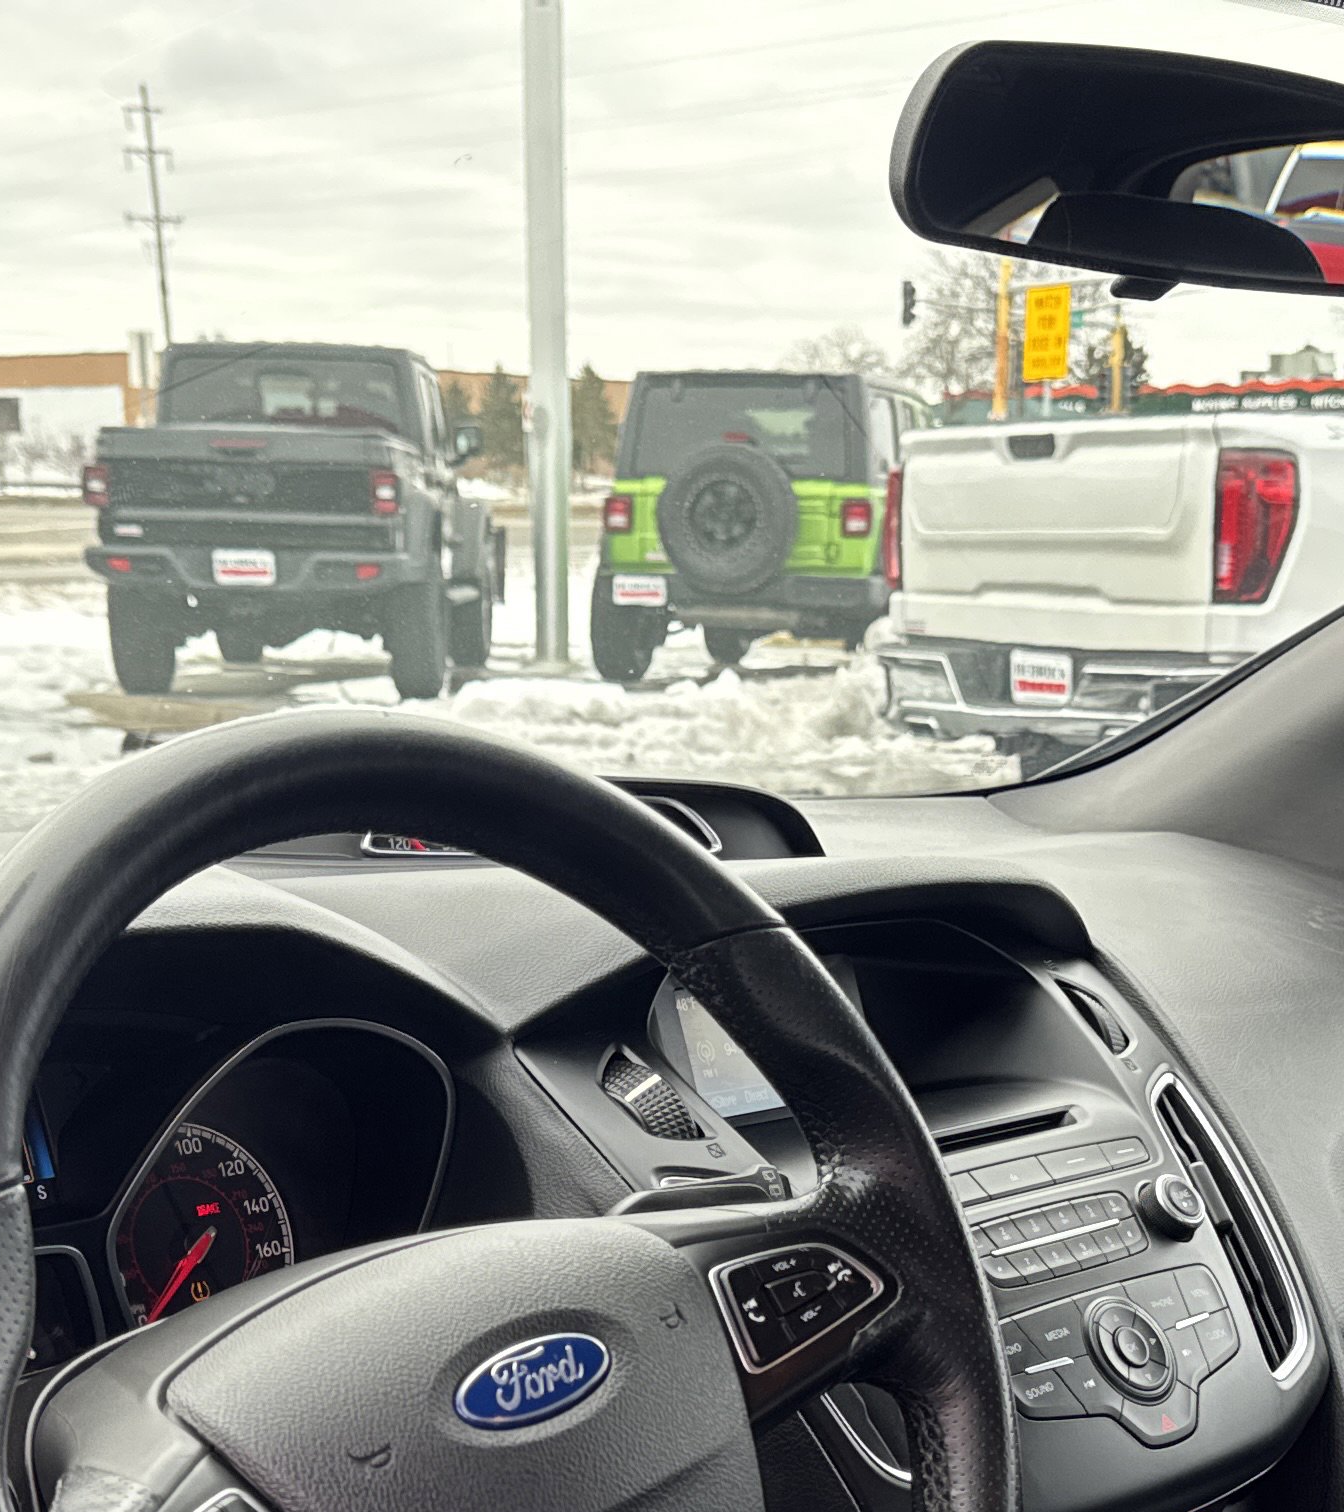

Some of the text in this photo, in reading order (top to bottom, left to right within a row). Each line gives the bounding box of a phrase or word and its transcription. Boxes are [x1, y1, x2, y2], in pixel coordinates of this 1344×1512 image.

[174, 1137, 204, 1156] 100
[218, 1159, 246, 1178] 120
[243, 1197, 270, 1216] 140
[256, 1240, 283, 1259] 160
[1044, 1327, 1070, 1342] MEDIA
[489, 1343, 586, 1413] Ford
[1025, 1381, 1055, 1400] SOUND
